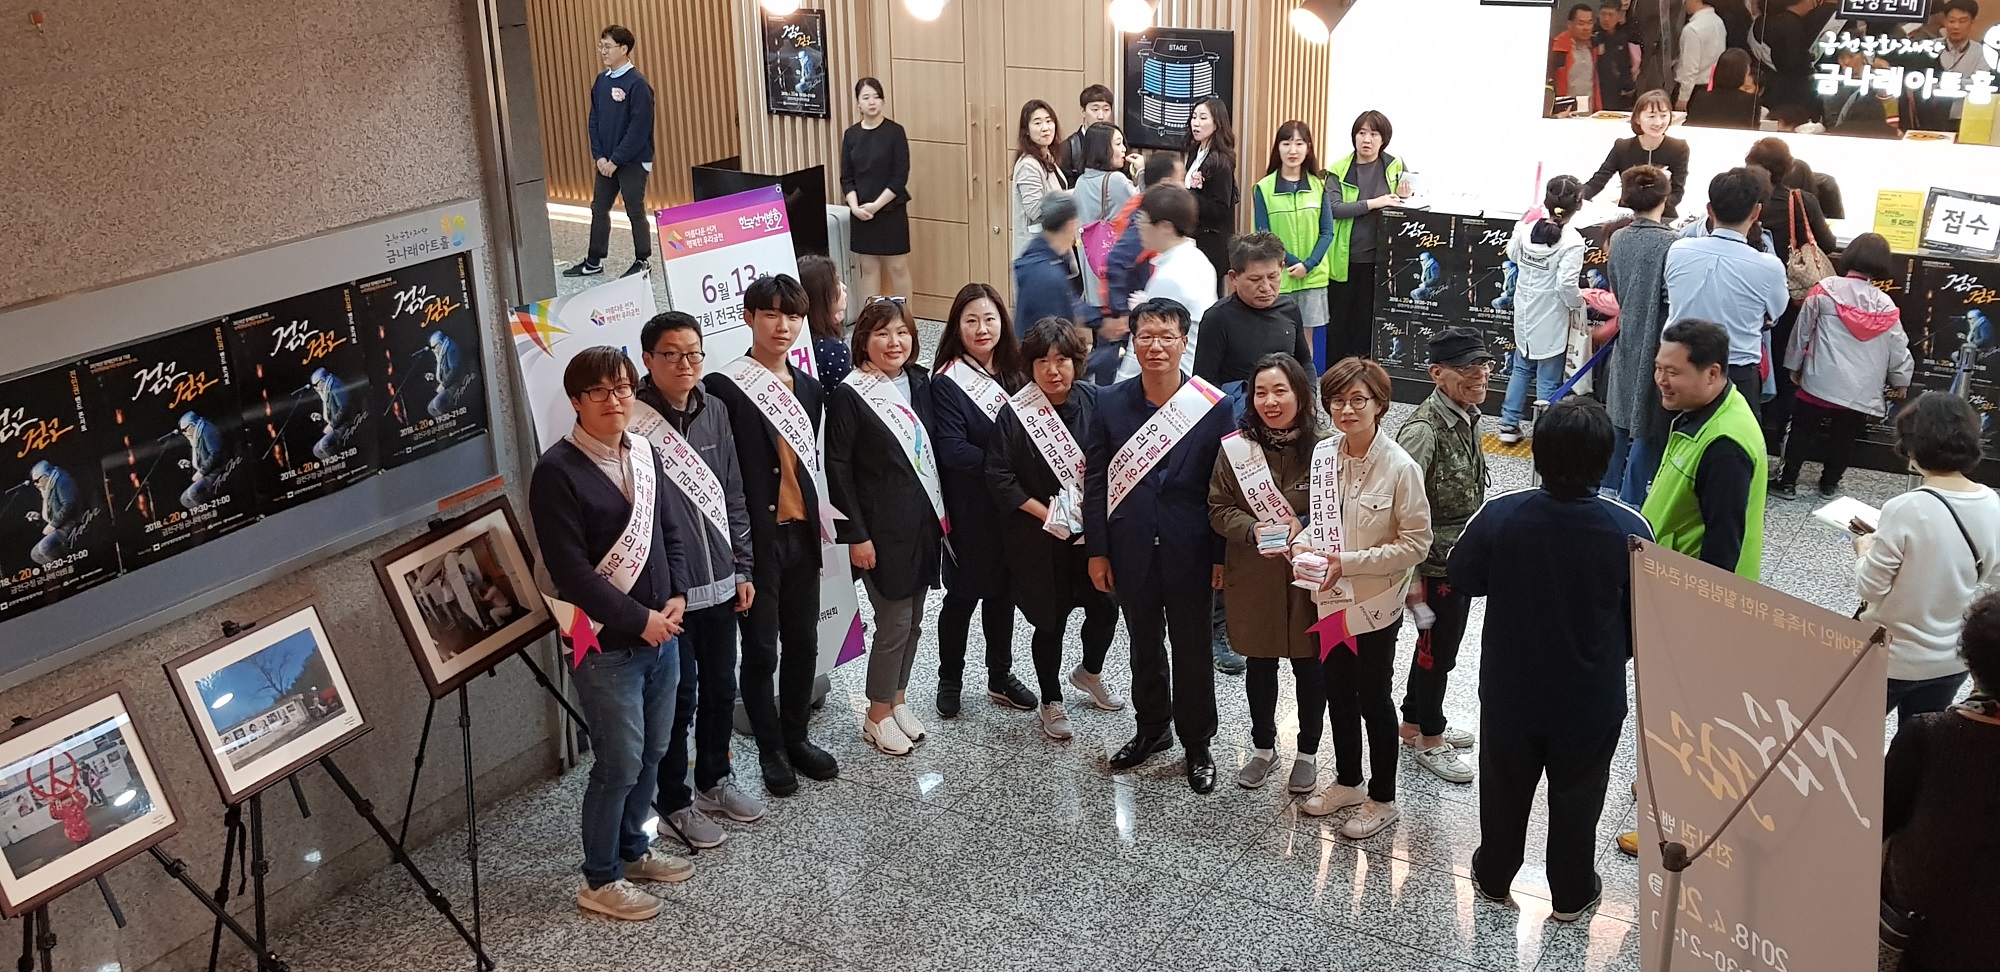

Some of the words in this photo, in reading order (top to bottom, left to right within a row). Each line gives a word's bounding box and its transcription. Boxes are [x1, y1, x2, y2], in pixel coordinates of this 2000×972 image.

[1168, 44, 1188, 52] STAGE
[1819, 31, 1946, 58] 금천문화재단
[1814, 63, 1999, 105] 금나래아트홀
[684, 227, 706, 239] 아름다운
[706, 224, 718, 235] 선거
[738, 207, 784, 232] 한국선거방송
[1942, 209, 1990, 235] 접수
[386, 235, 450, 264] 금나래아트홀
[701, 274, 731, 304] 6월
[767, 380, 809, 431] 아름다운
[757, 392, 782, 416] 우리
[779, 418, 810, 456] 금천의
[1037, 405, 1078, 458] 아름다운
[1135, 423, 1159, 450] 우리
[662, 431, 709, 482] 아름다운
[1026, 415, 1048, 439] 우리
[1043, 443, 1074, 482] 금천의
[1125, 433, 1172, 483] 아름다운
[635, 468, 645, 500] 우리
[653, 446, 679, 471] 우리
[676, 470, 712, 509] 금천의
[1312, 458, 1323, 489] 우리
[1324, 455, 1338, 520] 아름다운
[641, 473, 655, 539] 아름다운
[1109, 481, 1127, 506] 선거
[1247, 487, 1270, 514] 우리
[620, 501, 644, 553] 금천의
[1312, 494, 1325, 543] 금천의
[625, 542, 648, 578] 선거
